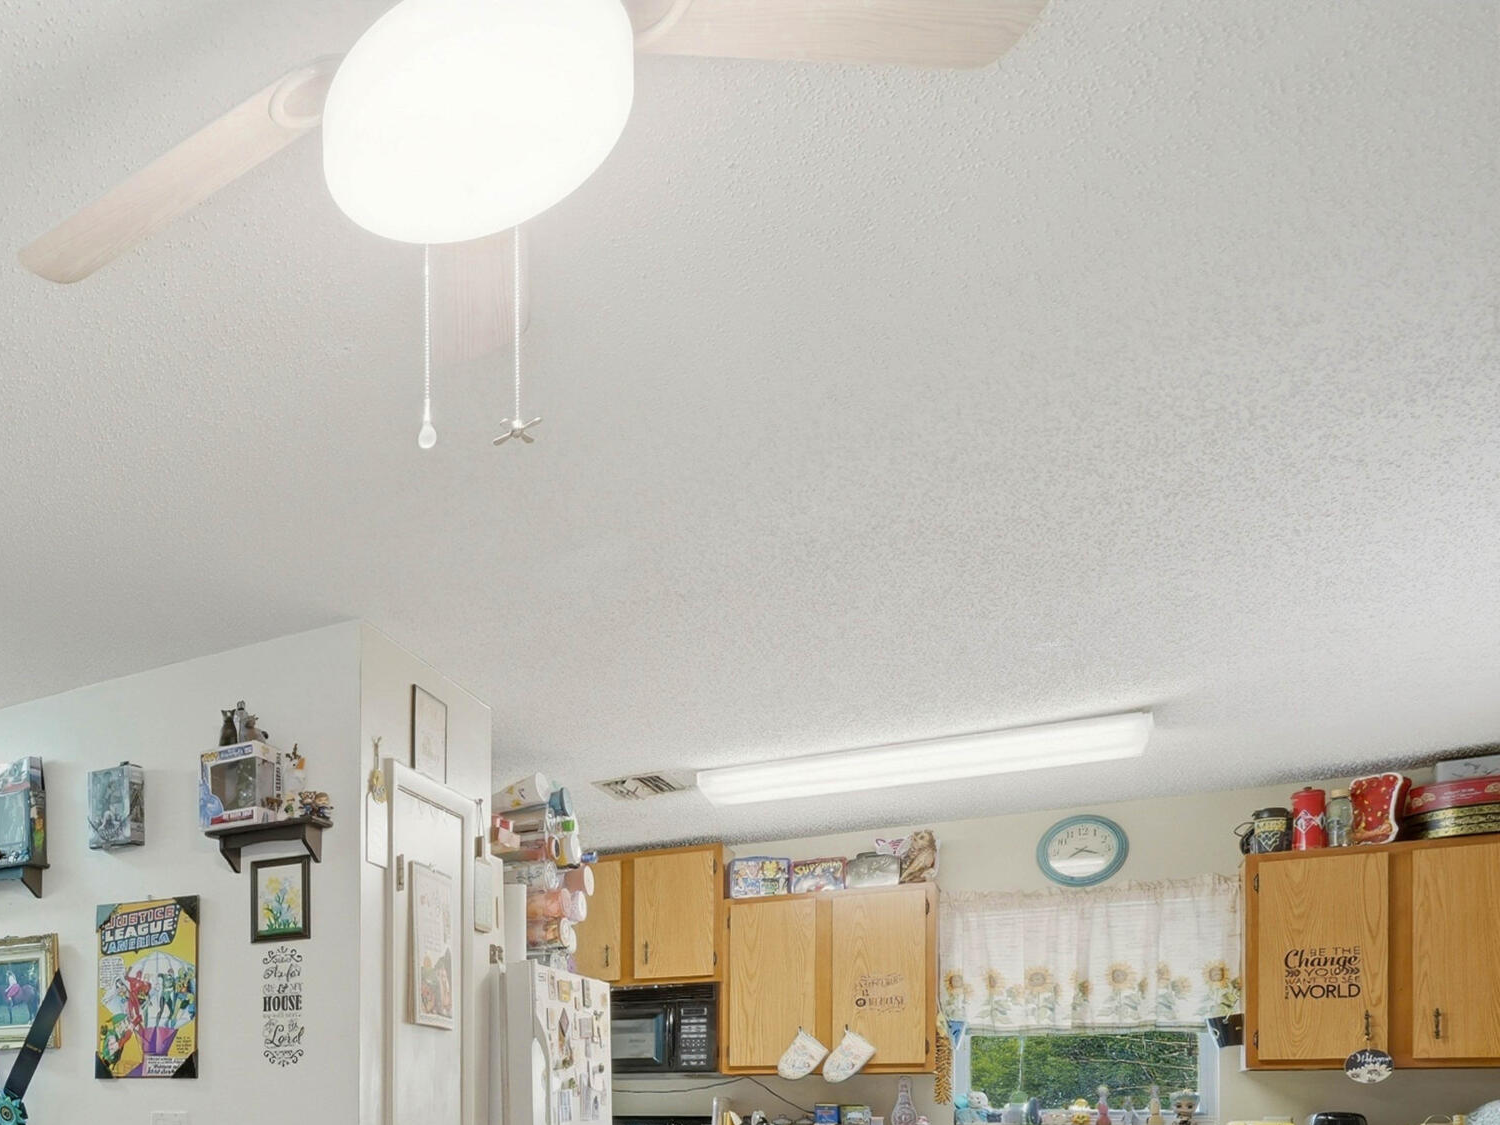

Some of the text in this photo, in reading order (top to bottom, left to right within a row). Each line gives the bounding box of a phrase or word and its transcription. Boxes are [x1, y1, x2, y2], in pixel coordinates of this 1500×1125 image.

[104, 904, 176, 929] JUSTICE
[105, 918, 174, 943] LEAGUE
[107, 932, 171, 953] AMERICA
[1310, 946, 1360, 957] BE THE
[1284, 949, 1360, 970] Change
[1289, 984, 1361, 999] WORLD
[263, 995, 302, 1012] HOUSE
